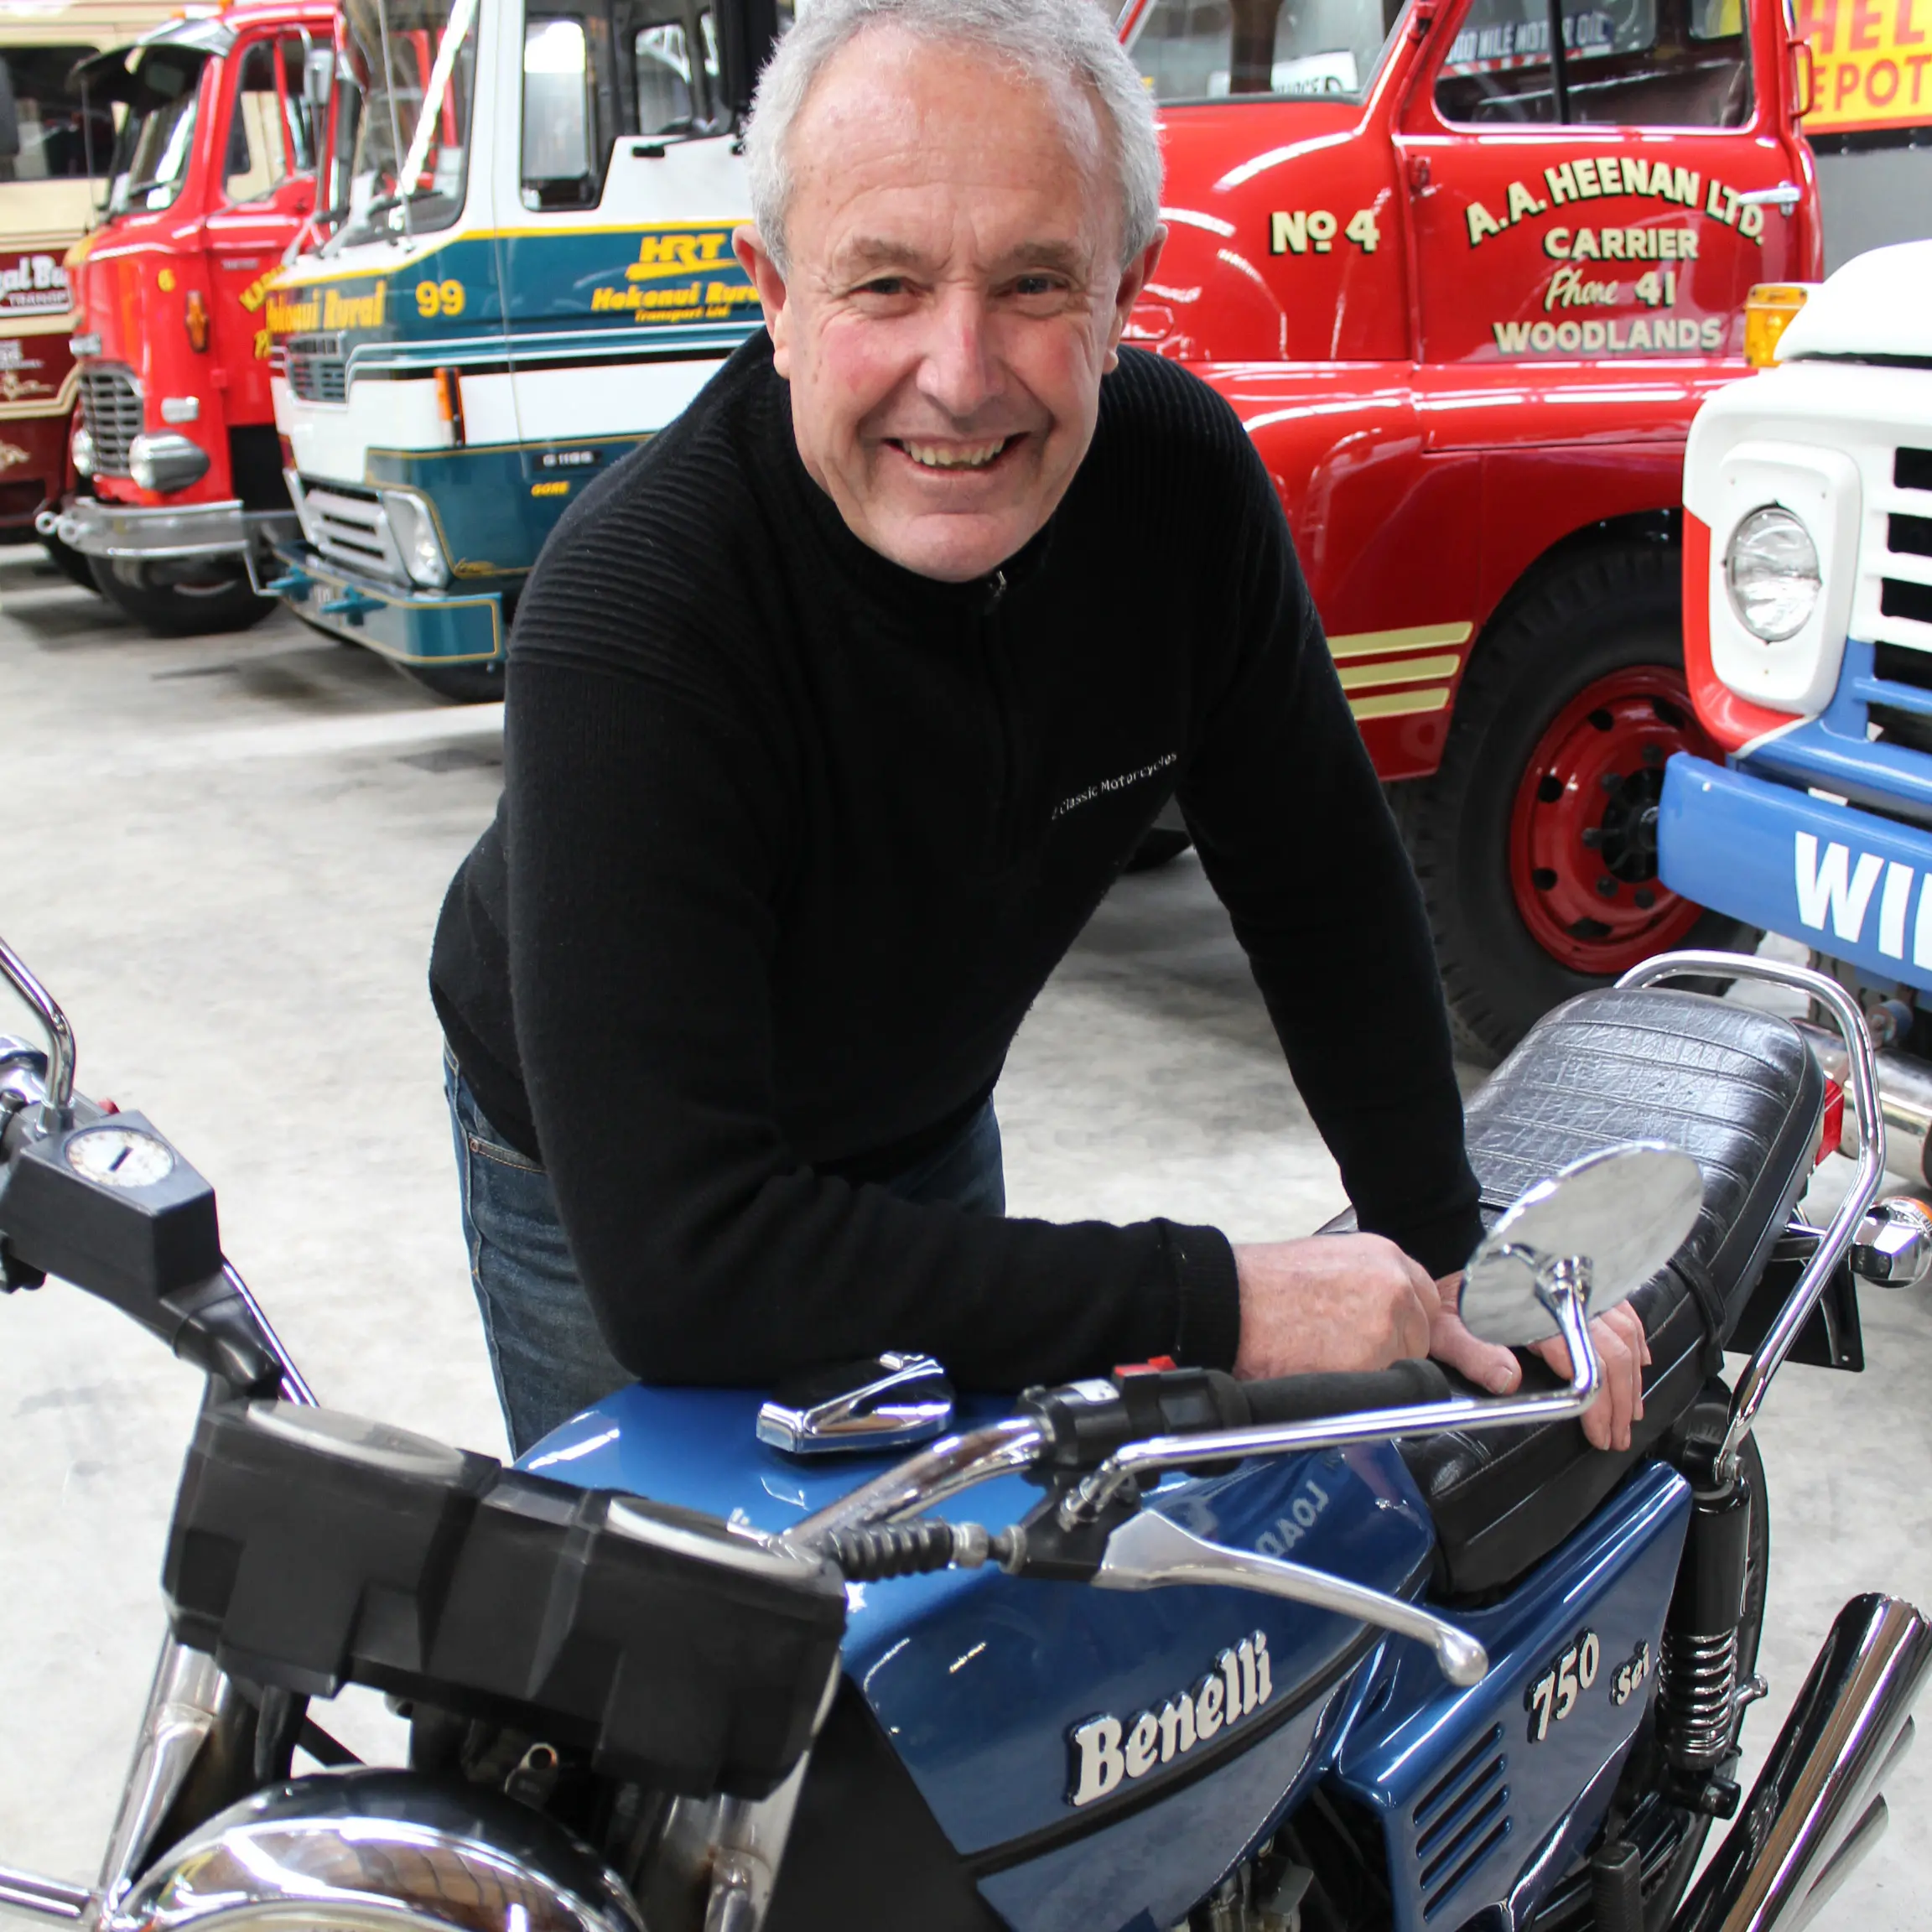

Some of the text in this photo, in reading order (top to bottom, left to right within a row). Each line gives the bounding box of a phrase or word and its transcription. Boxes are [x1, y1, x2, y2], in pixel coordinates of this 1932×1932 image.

[1514, 17, 1575, 55] MOTR
[1576, 11, 1611, 47] OIL
[1799, 54, 1932, 114] EPOT
[1543, 157, 1701, 208] HEENAN
[638, 232, 728, 266] HRT
[1344, 209, 1381, 253] 4
[1544, 227, 1700, 260] CARRIER
[324, 279, 387, 330] Rural
[415, 278, 466, 318] 99
[1544, 267, 1677, 314] Phone 41
[1492, 318, 1722, 356] WOODLANDS
[1101, 751, 1177, 793] Motorcycles
[1525, 1628, 1600, 1742] 750
[1065, 1628, 1273, 1807] Benelli
